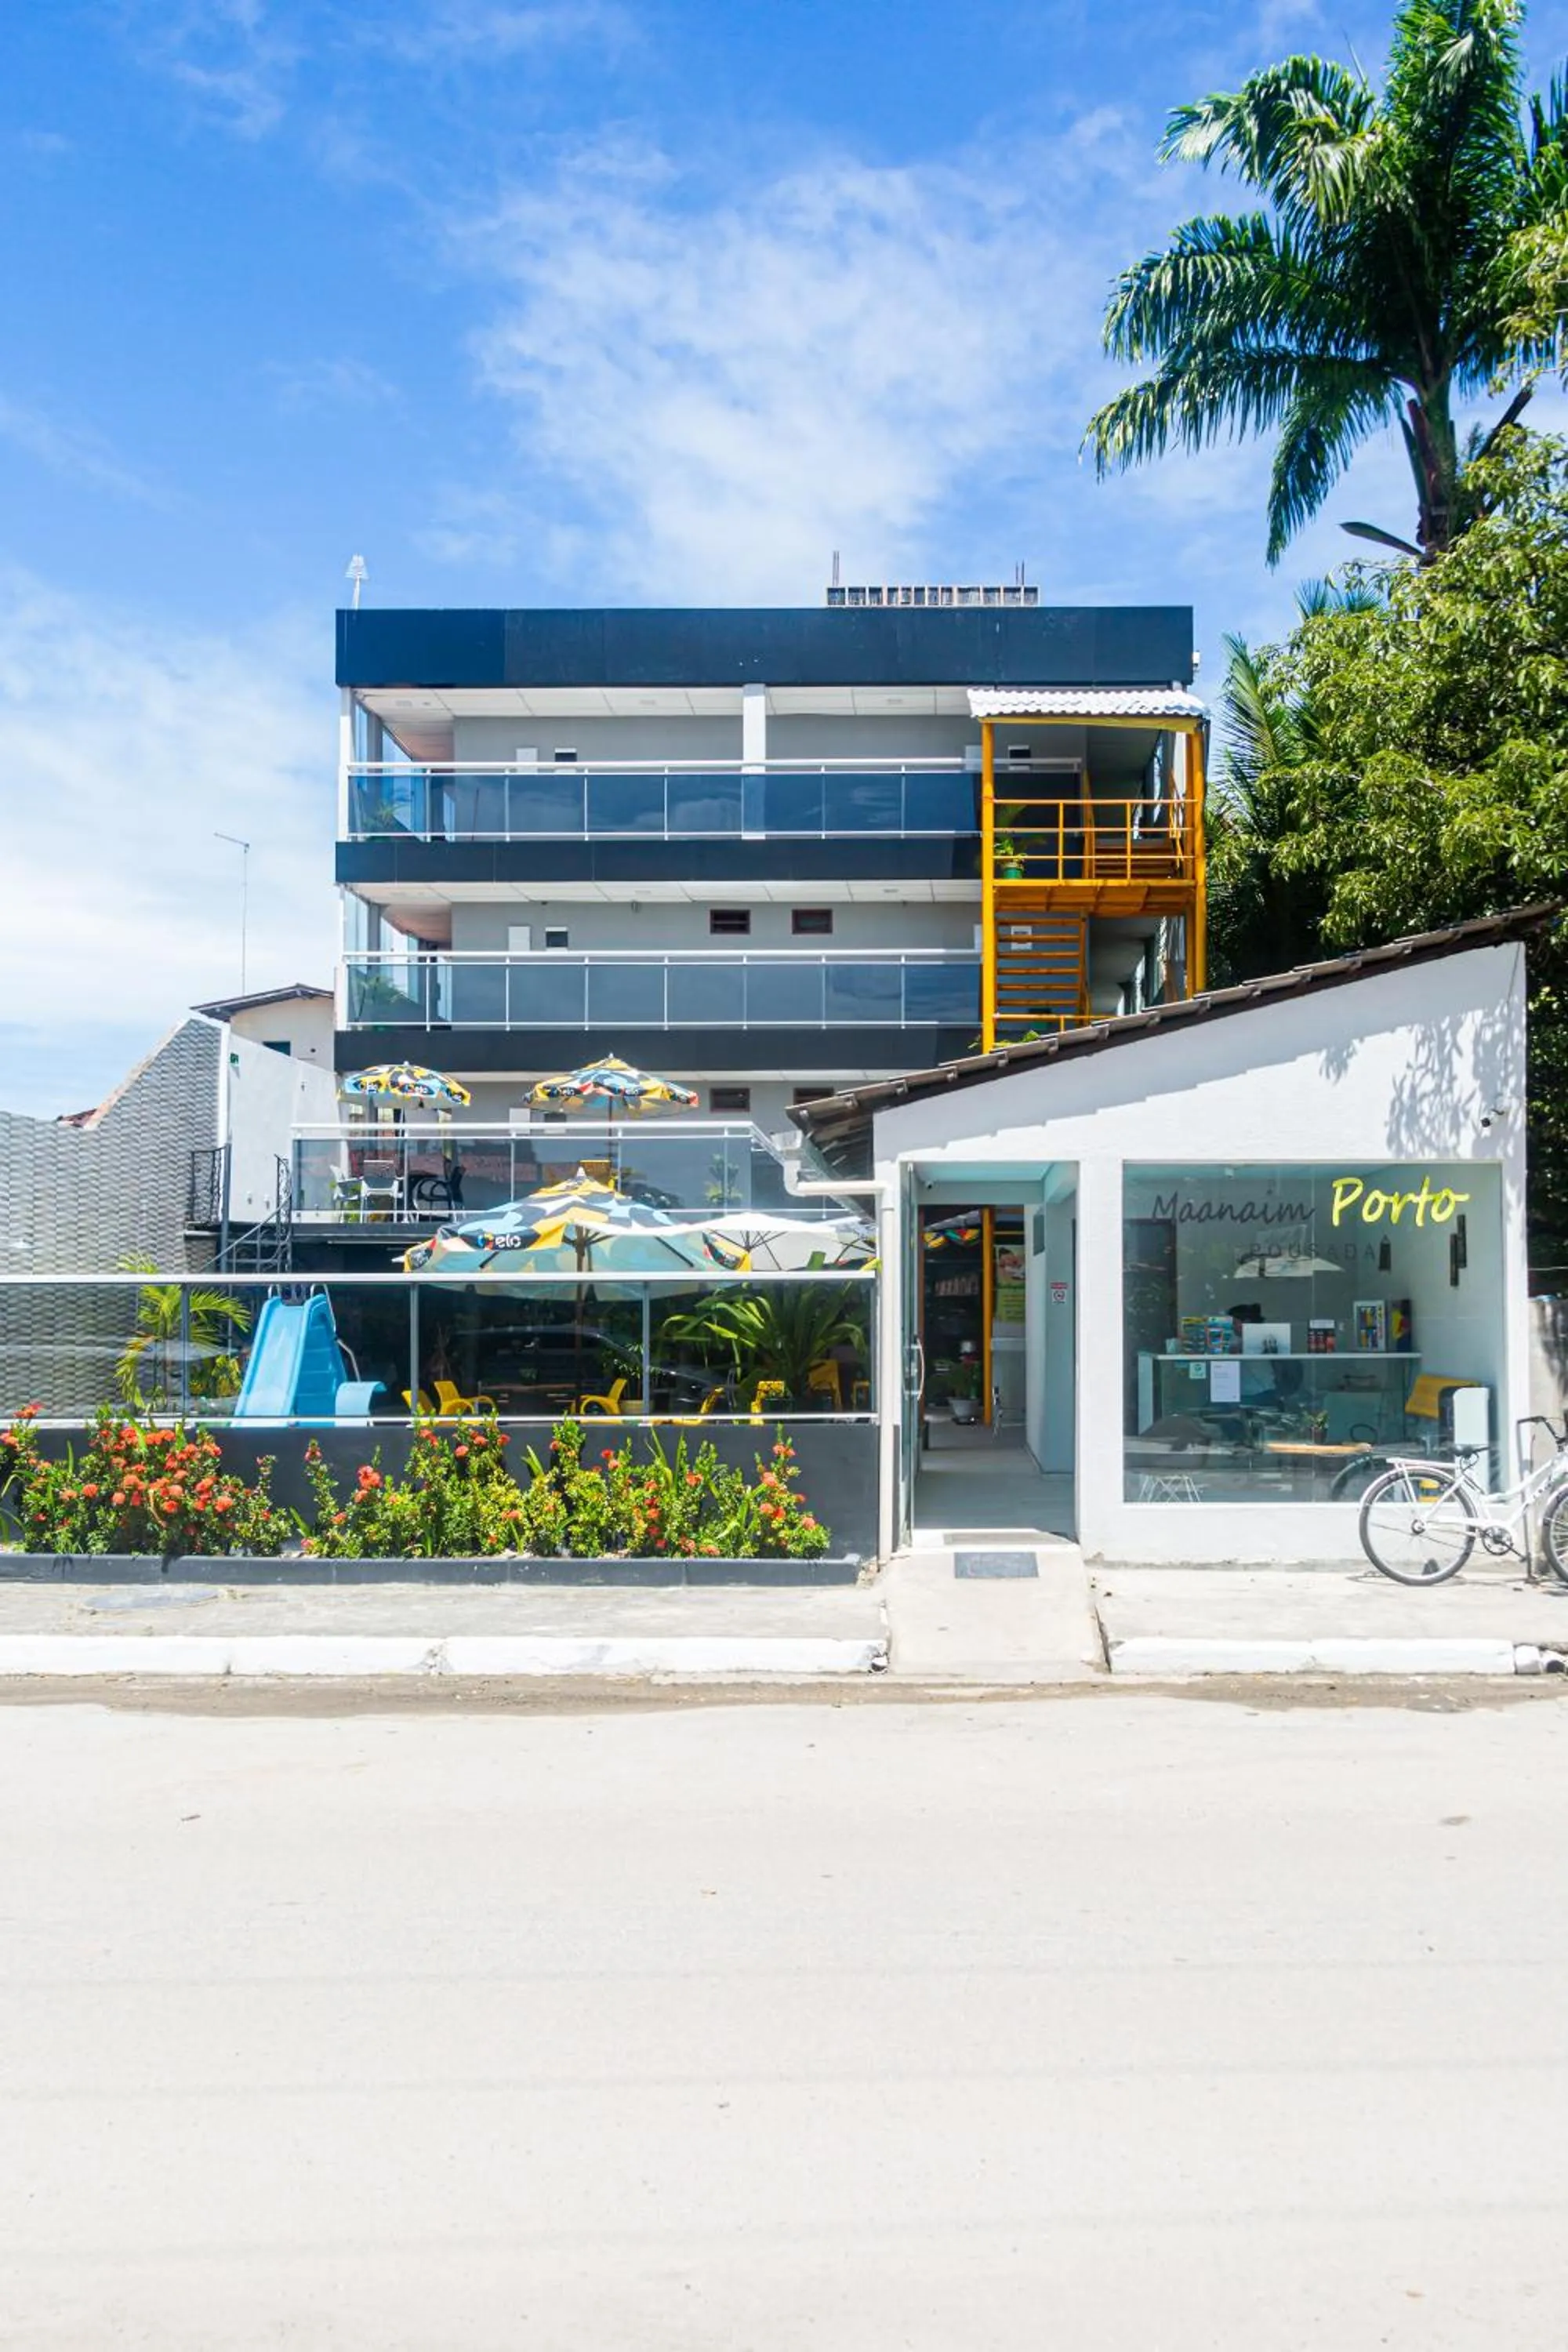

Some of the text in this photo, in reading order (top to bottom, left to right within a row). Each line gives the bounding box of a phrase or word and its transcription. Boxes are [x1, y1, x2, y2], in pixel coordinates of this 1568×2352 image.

[1152, 1175, 1470, 1227] Maanaim Porto
[495, 1235, 521, 1248] elo
